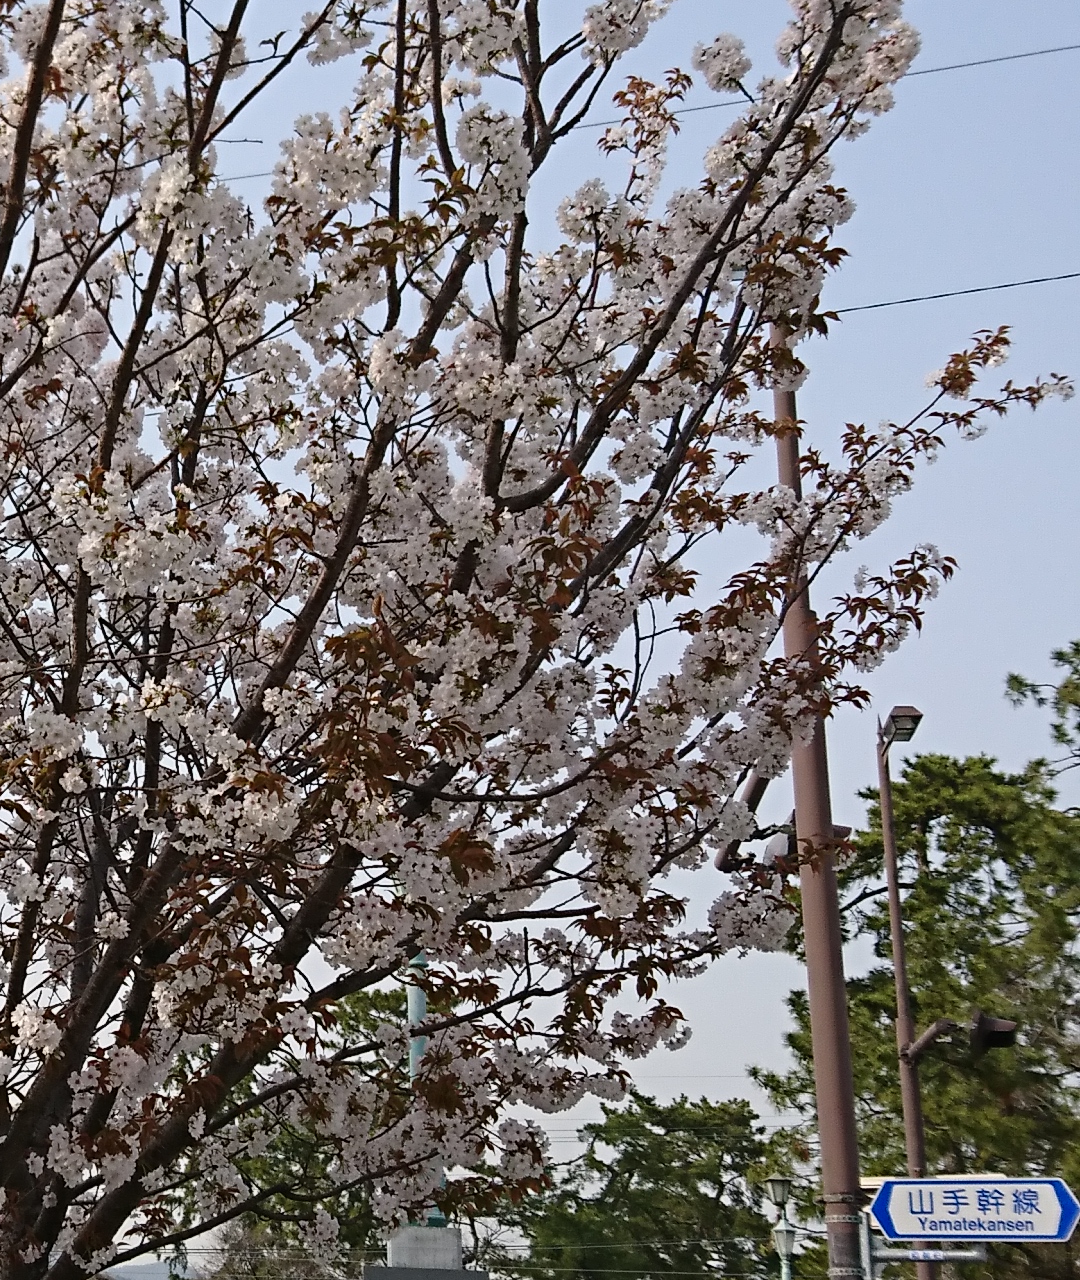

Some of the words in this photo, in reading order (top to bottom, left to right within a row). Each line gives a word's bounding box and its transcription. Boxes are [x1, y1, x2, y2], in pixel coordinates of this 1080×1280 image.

[908, 1188, 1042, 1216] 山手幹線
[917, 1217, 1035, 1232] Yamatekansen
